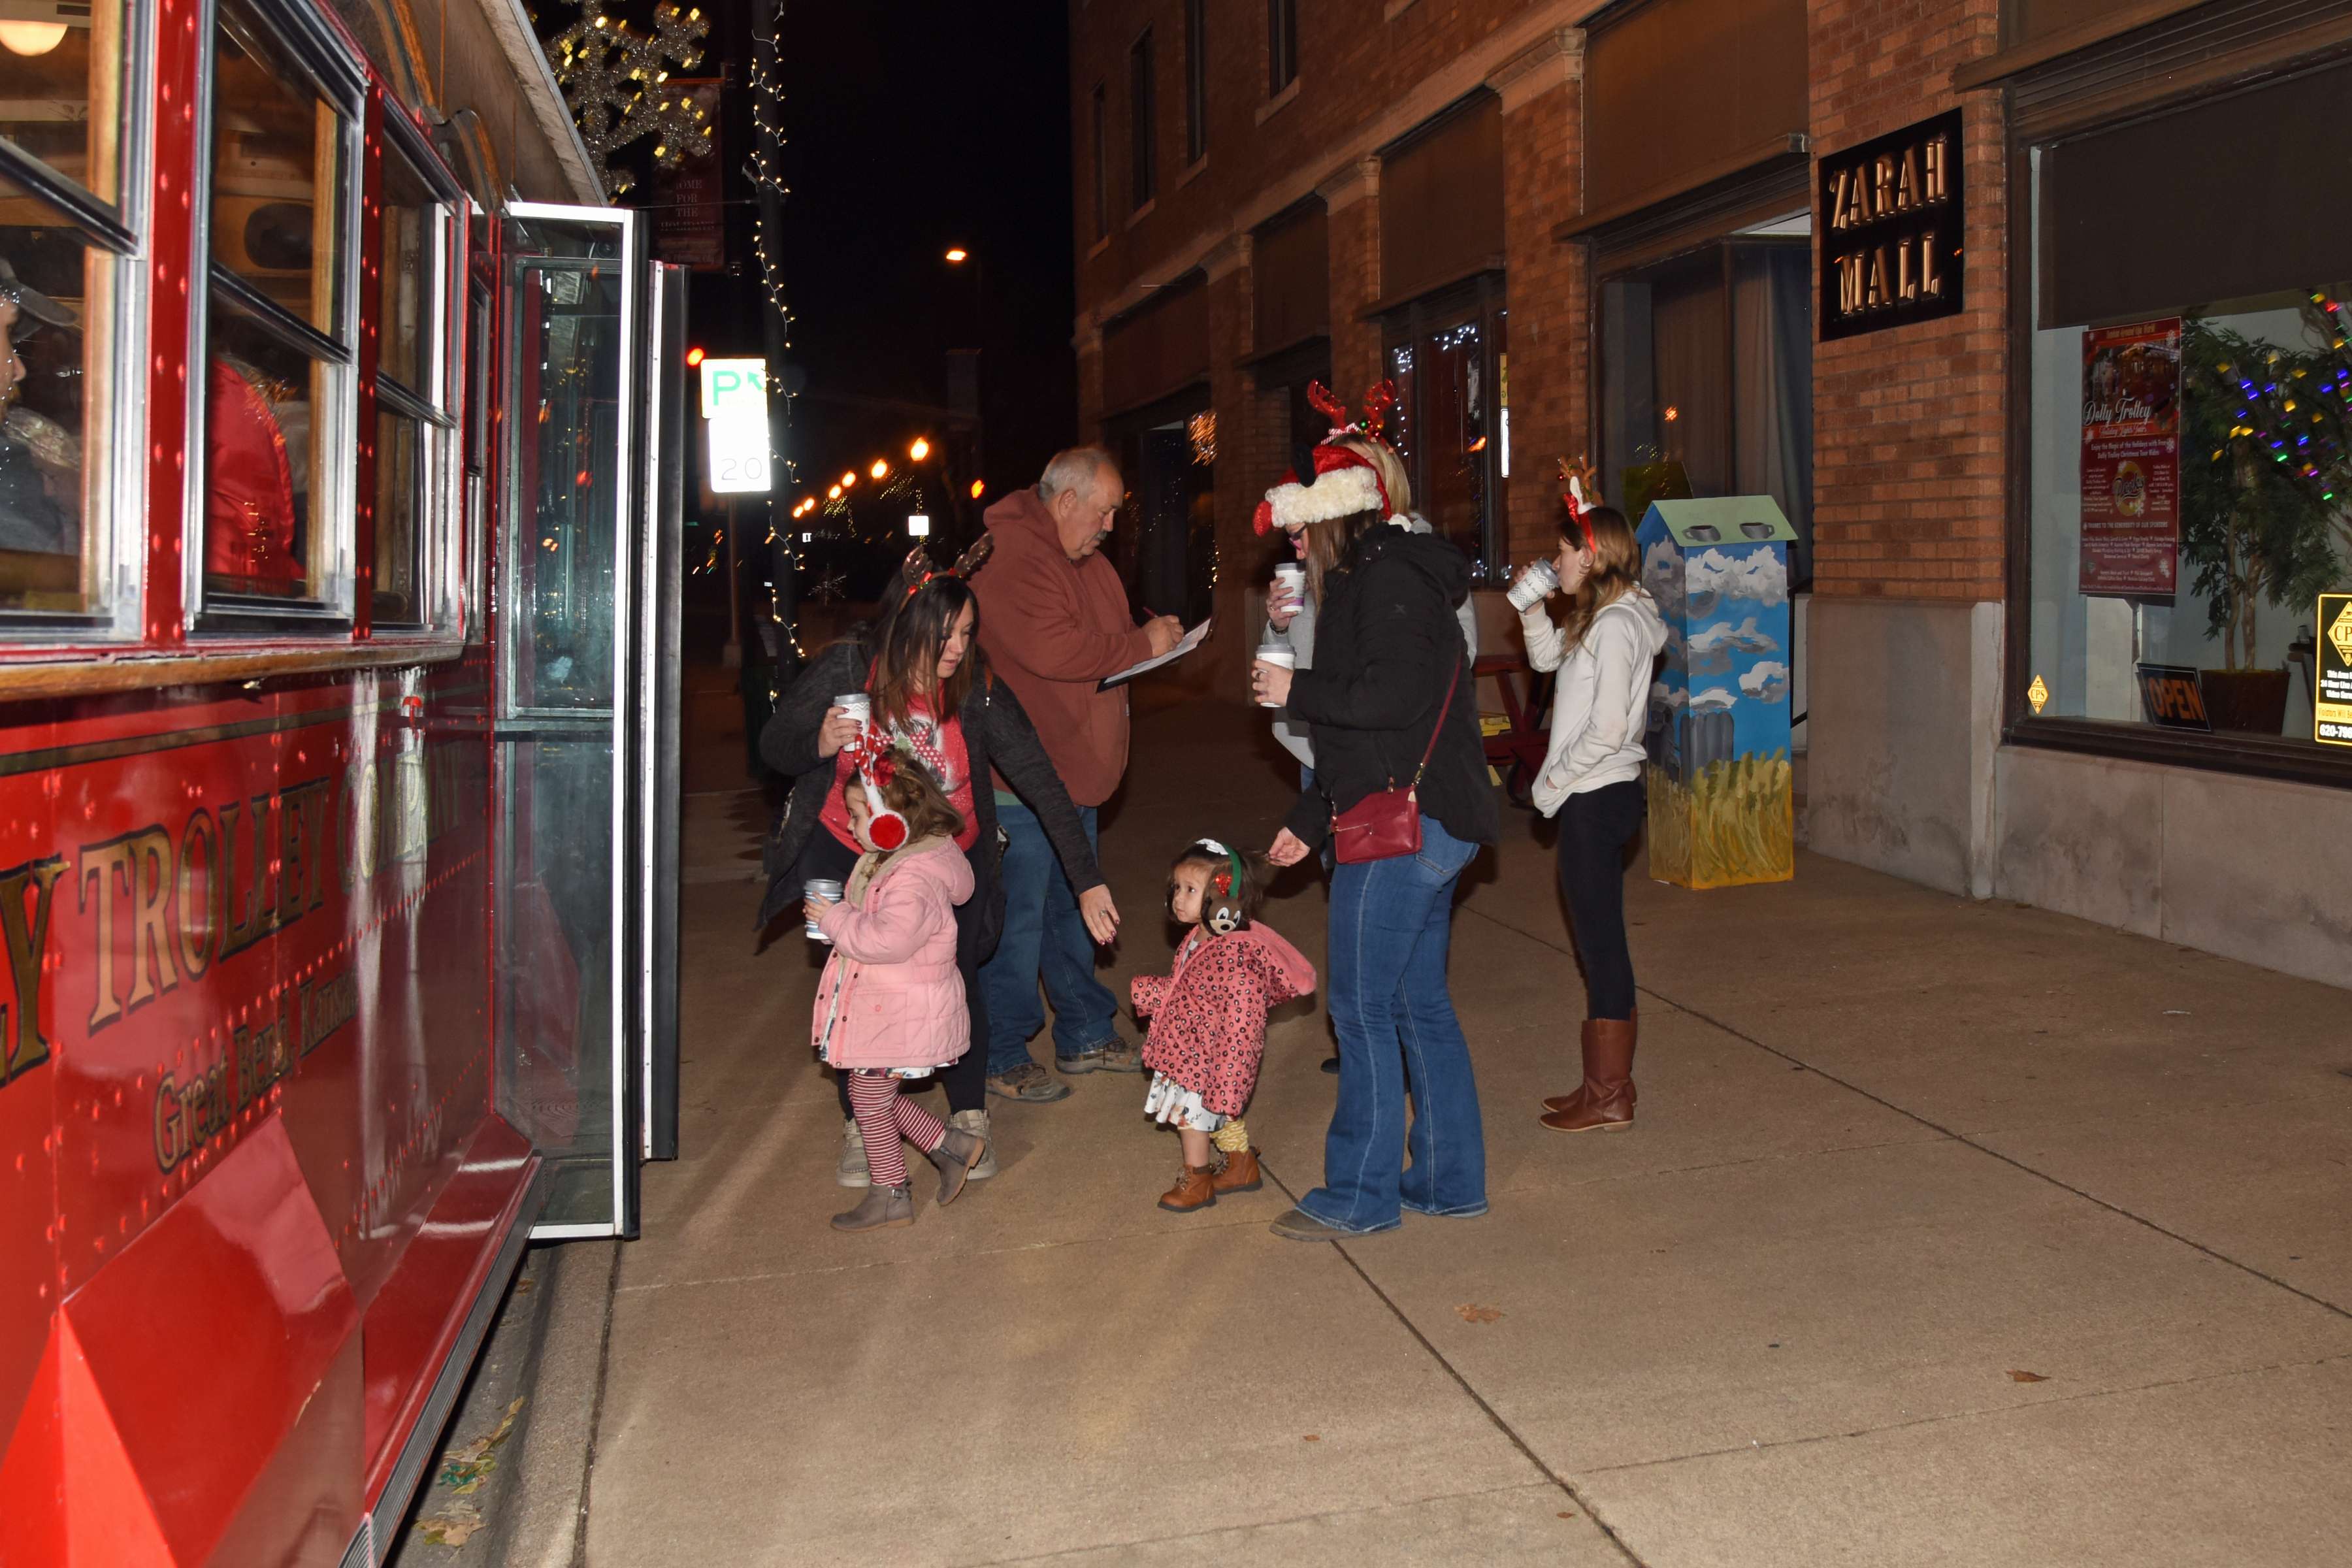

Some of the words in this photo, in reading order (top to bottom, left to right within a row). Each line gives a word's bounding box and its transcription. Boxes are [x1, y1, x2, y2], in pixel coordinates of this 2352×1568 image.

[676, 194, 697, 203] FOR
[1829, 139, 1948, 230] ZARAH
[676, 208, 698, 218] THE
[1840, 234, 1939, 314] MALL
[713, 370, 741, 406] P
[2083, 400, 2112, 427] Dolly
[2115, 397, 2151, 424] Trolley
[721, 457, 762, 480] 20
[2031, 689, 2044, 700] CPS
[2148, 678, 2206, 721] OPEN
[0, 853, 71, 1090] Y
[78, 776, 330, 1039] TROLLEY
[154, 1044, 230, 1175] Great
